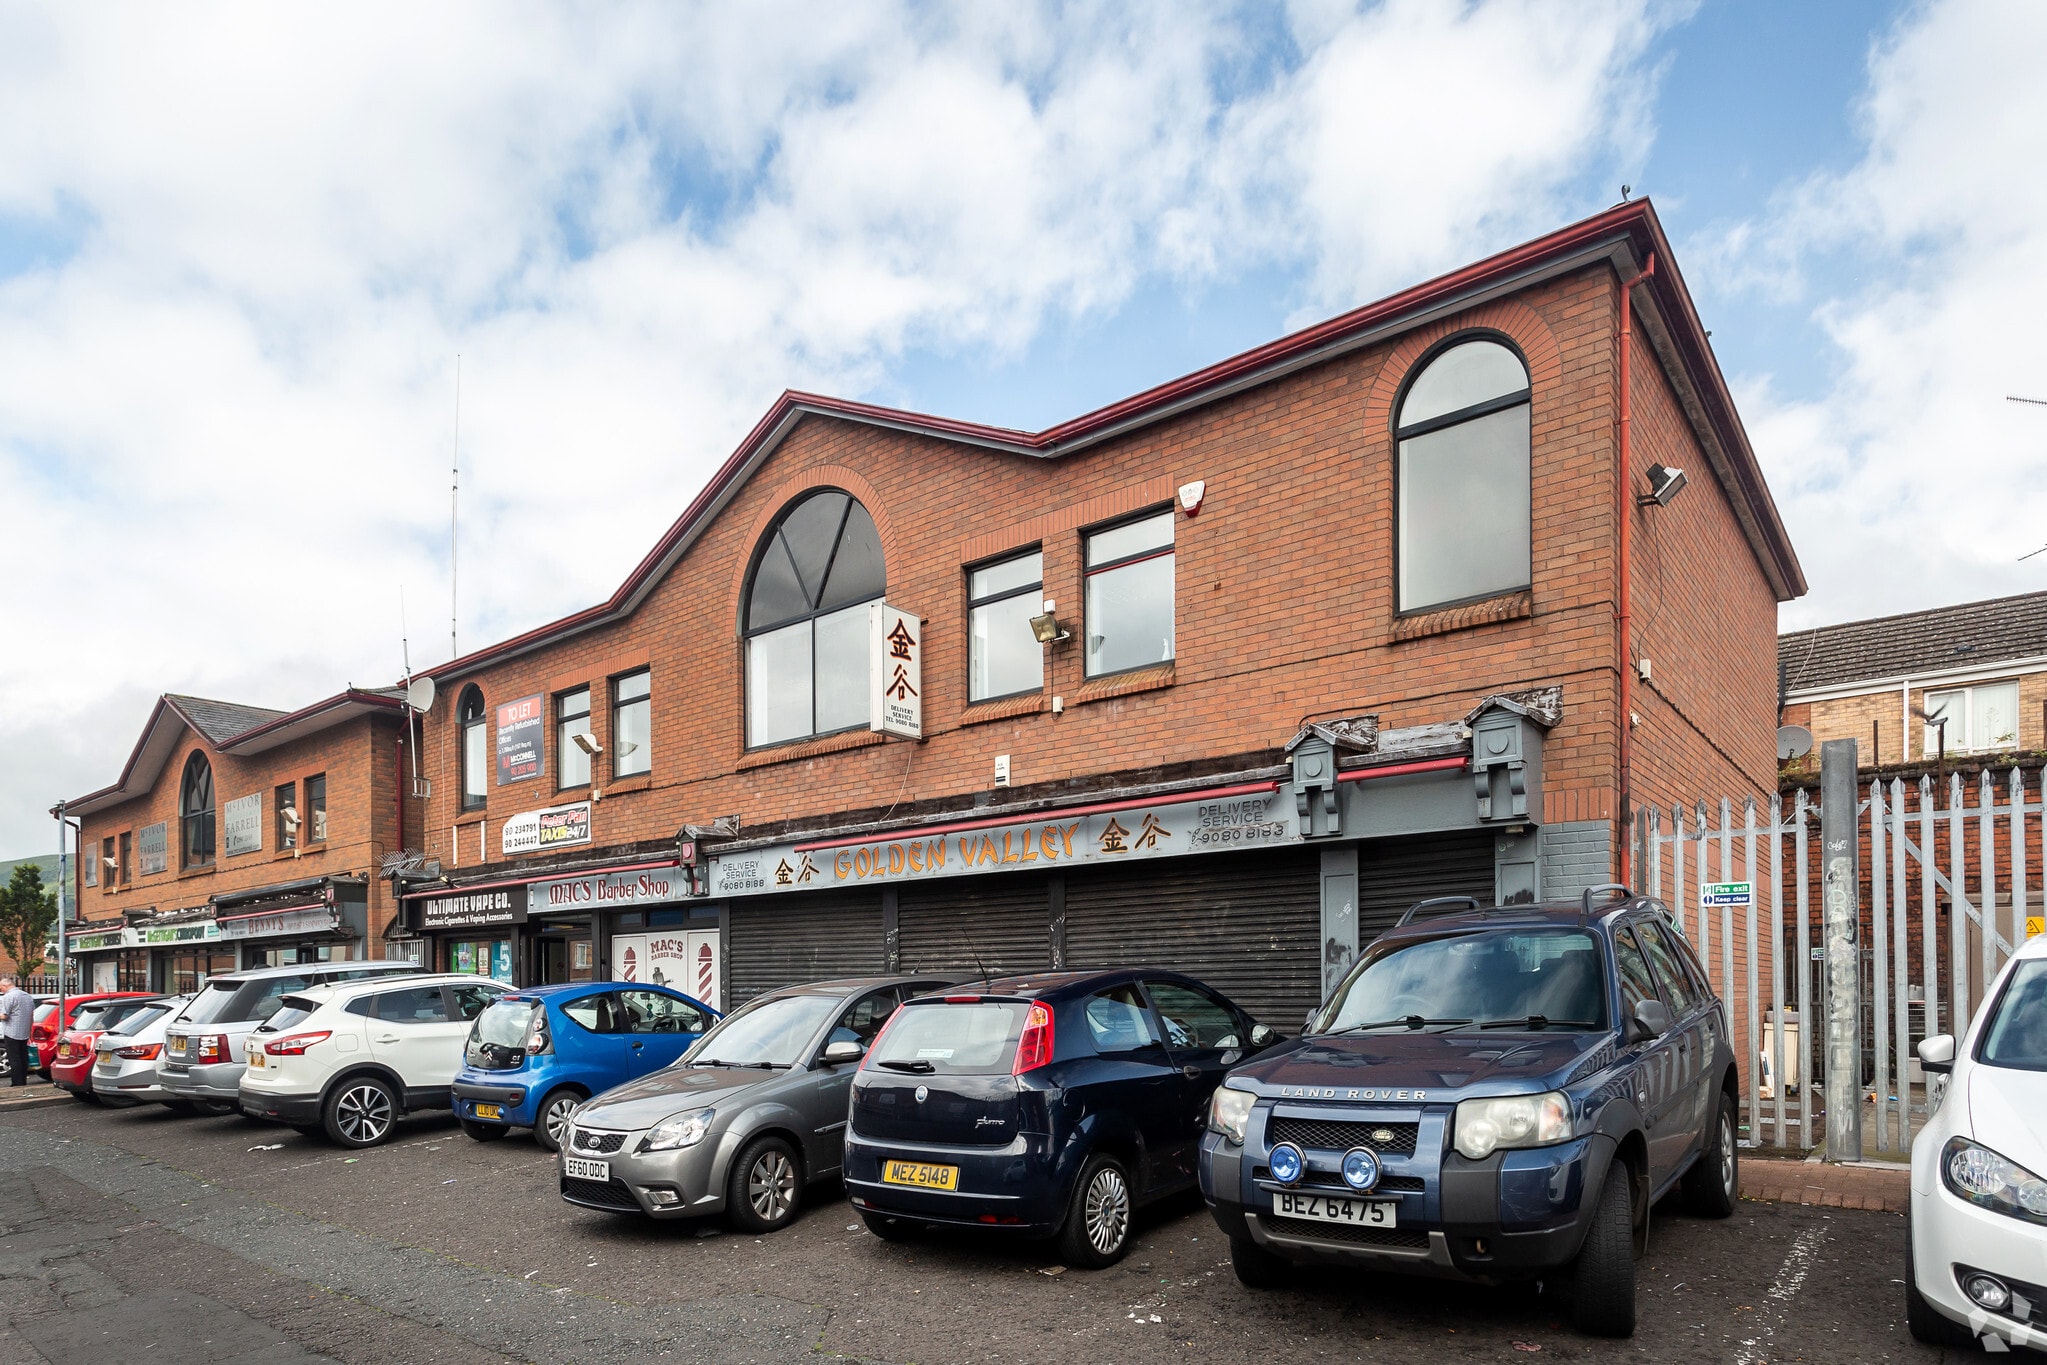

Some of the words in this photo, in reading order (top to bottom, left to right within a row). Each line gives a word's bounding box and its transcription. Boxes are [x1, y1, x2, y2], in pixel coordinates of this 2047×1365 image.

[886, 618, 918, 701] 金谷
[508, 707, 518, 721] TO
[519, 703, 531, 718] LET
[891, 705, 913, 715] DELIVERY
[893, 712, 912, 721] SERVICE
[515, 717, 540, 730] Refurbished
[1199, 799, 1272, 818] DELIVERY
[226, 816, 260, 834] FARRELL
[541, 815, 567, 829] Peter
[567, 810, 587, 824] Pan
[1202, 812, 1263, 827] SERVICE
[541, 826, 567, 842] TAXIS
[567, 825, 586, 838] 24/7
[1099, 813, 1171, 853] 金谷
[1202, 830, 1241, 843] 9080
[504, 839, 512, 848] 90
[834, 838, 946, 879] GOLDEN
[959, 822, 1080, 867] VALLEY
[722, 860, 759, 872] DELIVERY
[726, 869, 756, 879] SERVICE
[775, 855, 820, 885] 金谷
[549, 879, 592, 905] MAC'S
[597, 877, 637, 900] Barber
[638, 874, 669, 898] Shop
[724, 881, 744, 890] 9080
[745, 880, 765, 889] 8188
[427, 896, 469, 915] ULTIMATE
[470, 893, 493, 912] VAPE
[249, 915, 283, 934] BENNY'S
[425, 917, 444, 926] Electronic
[445, 916, 465, 926] Cigarettes
[470, 914, 485, 924] Vaping
[486, 911, 513, 922] Accessories
[650, 939, 683, 953] MAC'S
[651, 952, 669, 960] BARBER
[671, 952, 683, 960] SHOP
[1281, 1087, 1336, 1098] LAND
[1347, 1089, 1427, 1100] ROVER
[569, 1159, 588, 1175] EF60
[891, 1163, 917, 1181] MEZ
[919, 1166, 949, 1185] 5148
[1282, 1194, 1320, 1216] BEZ
[1326, 1199, 1384, 1223] 6475
